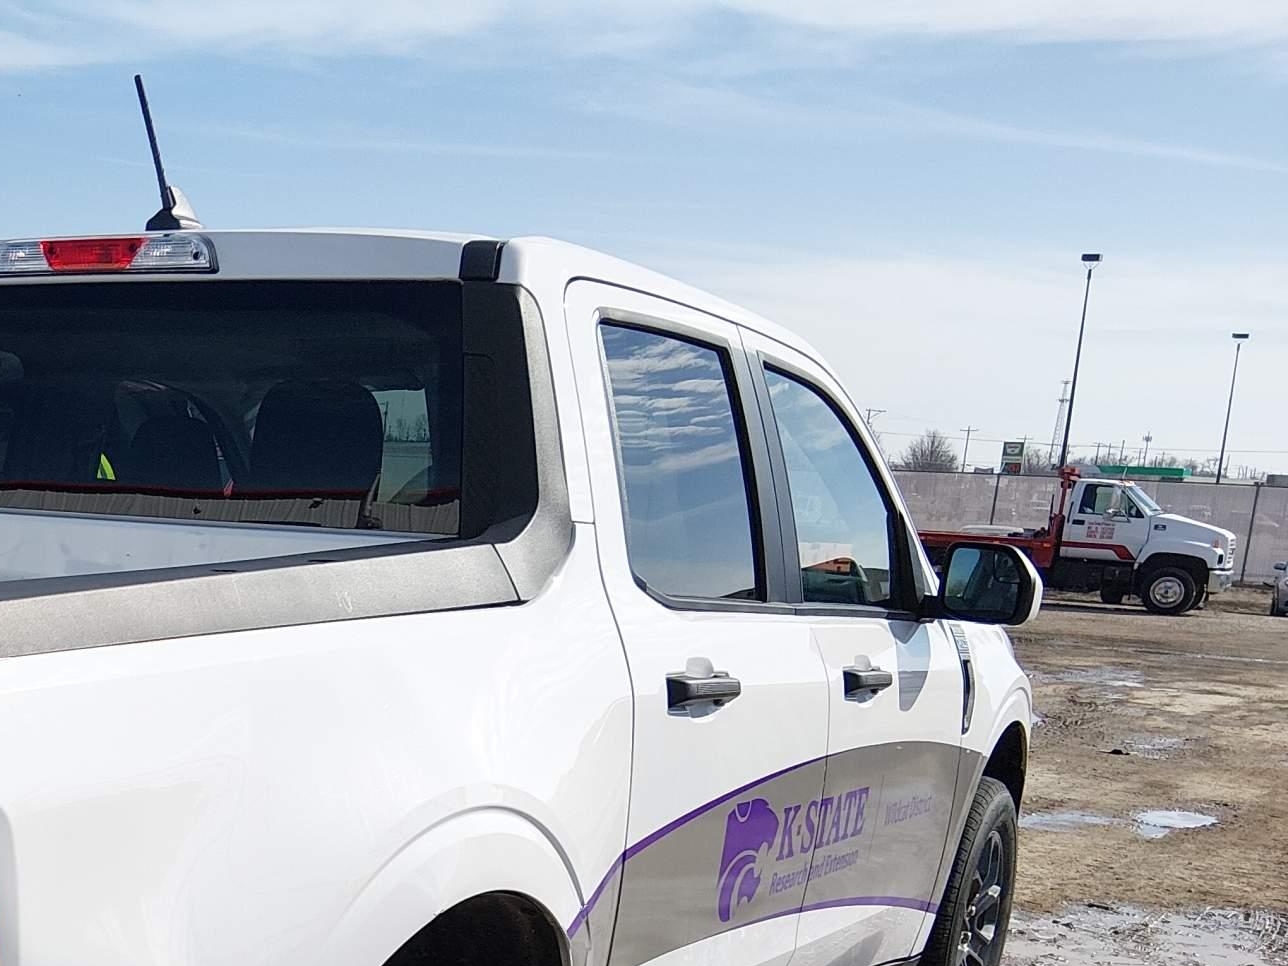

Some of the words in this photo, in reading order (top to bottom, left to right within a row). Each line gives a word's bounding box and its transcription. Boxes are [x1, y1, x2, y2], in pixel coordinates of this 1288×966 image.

[769, 864, 809, 896] Research
[809, 855, 825, 881] and
[824, 849, 859, 876] Extension
